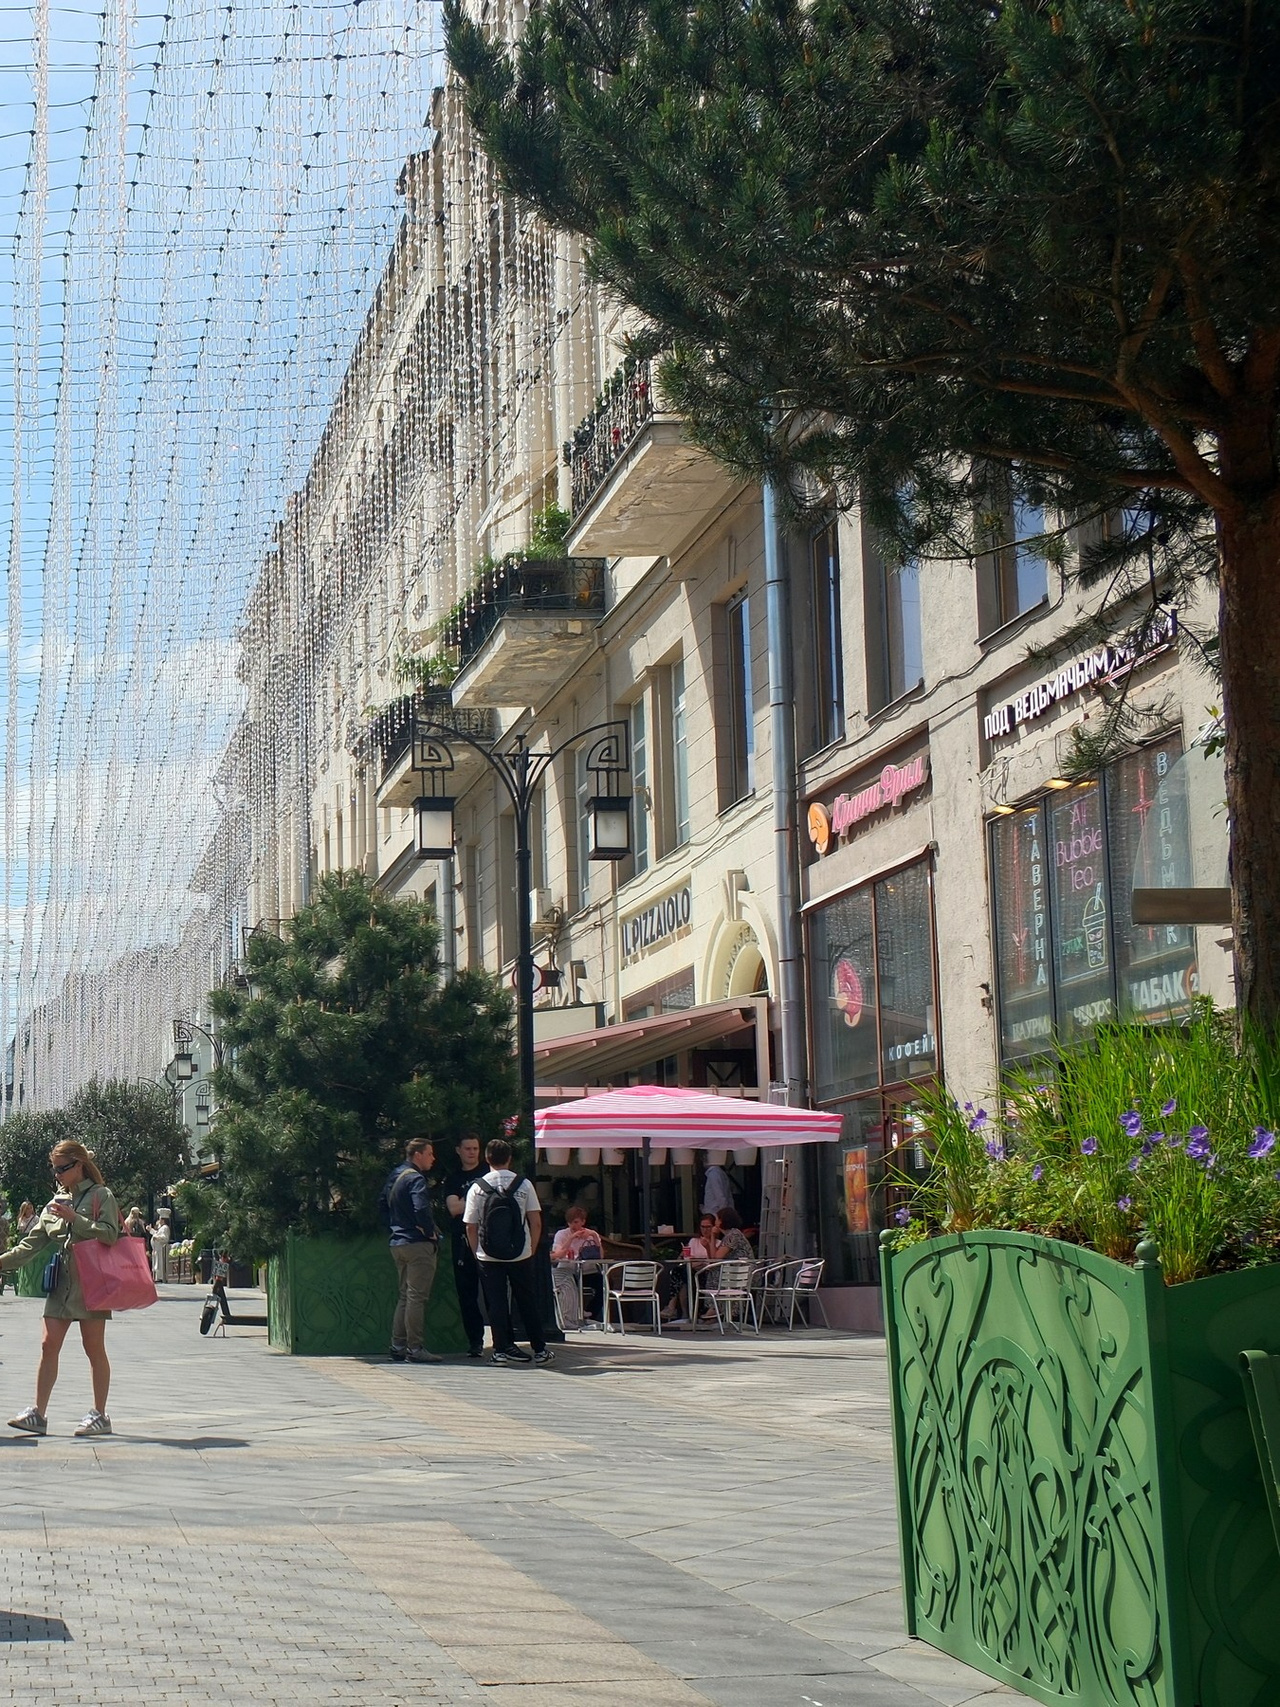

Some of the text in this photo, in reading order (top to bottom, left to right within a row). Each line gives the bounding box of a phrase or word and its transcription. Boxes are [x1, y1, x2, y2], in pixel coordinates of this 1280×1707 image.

[984, 709, 1011, 740] ПОД
[1014, 645, 1110, 723] ВЕДЬМАЧЬИМ
[1056, 827, 1103, 867] Bubble
[1156, 751, 1178, 945] ВЕДЬМК
[632, 887, 691, 952] PIZZAIOLO
[1028, 813, 1047, 986] ТАВЕРНА
[1129, 970, 1187, 1011] ТАБАК
